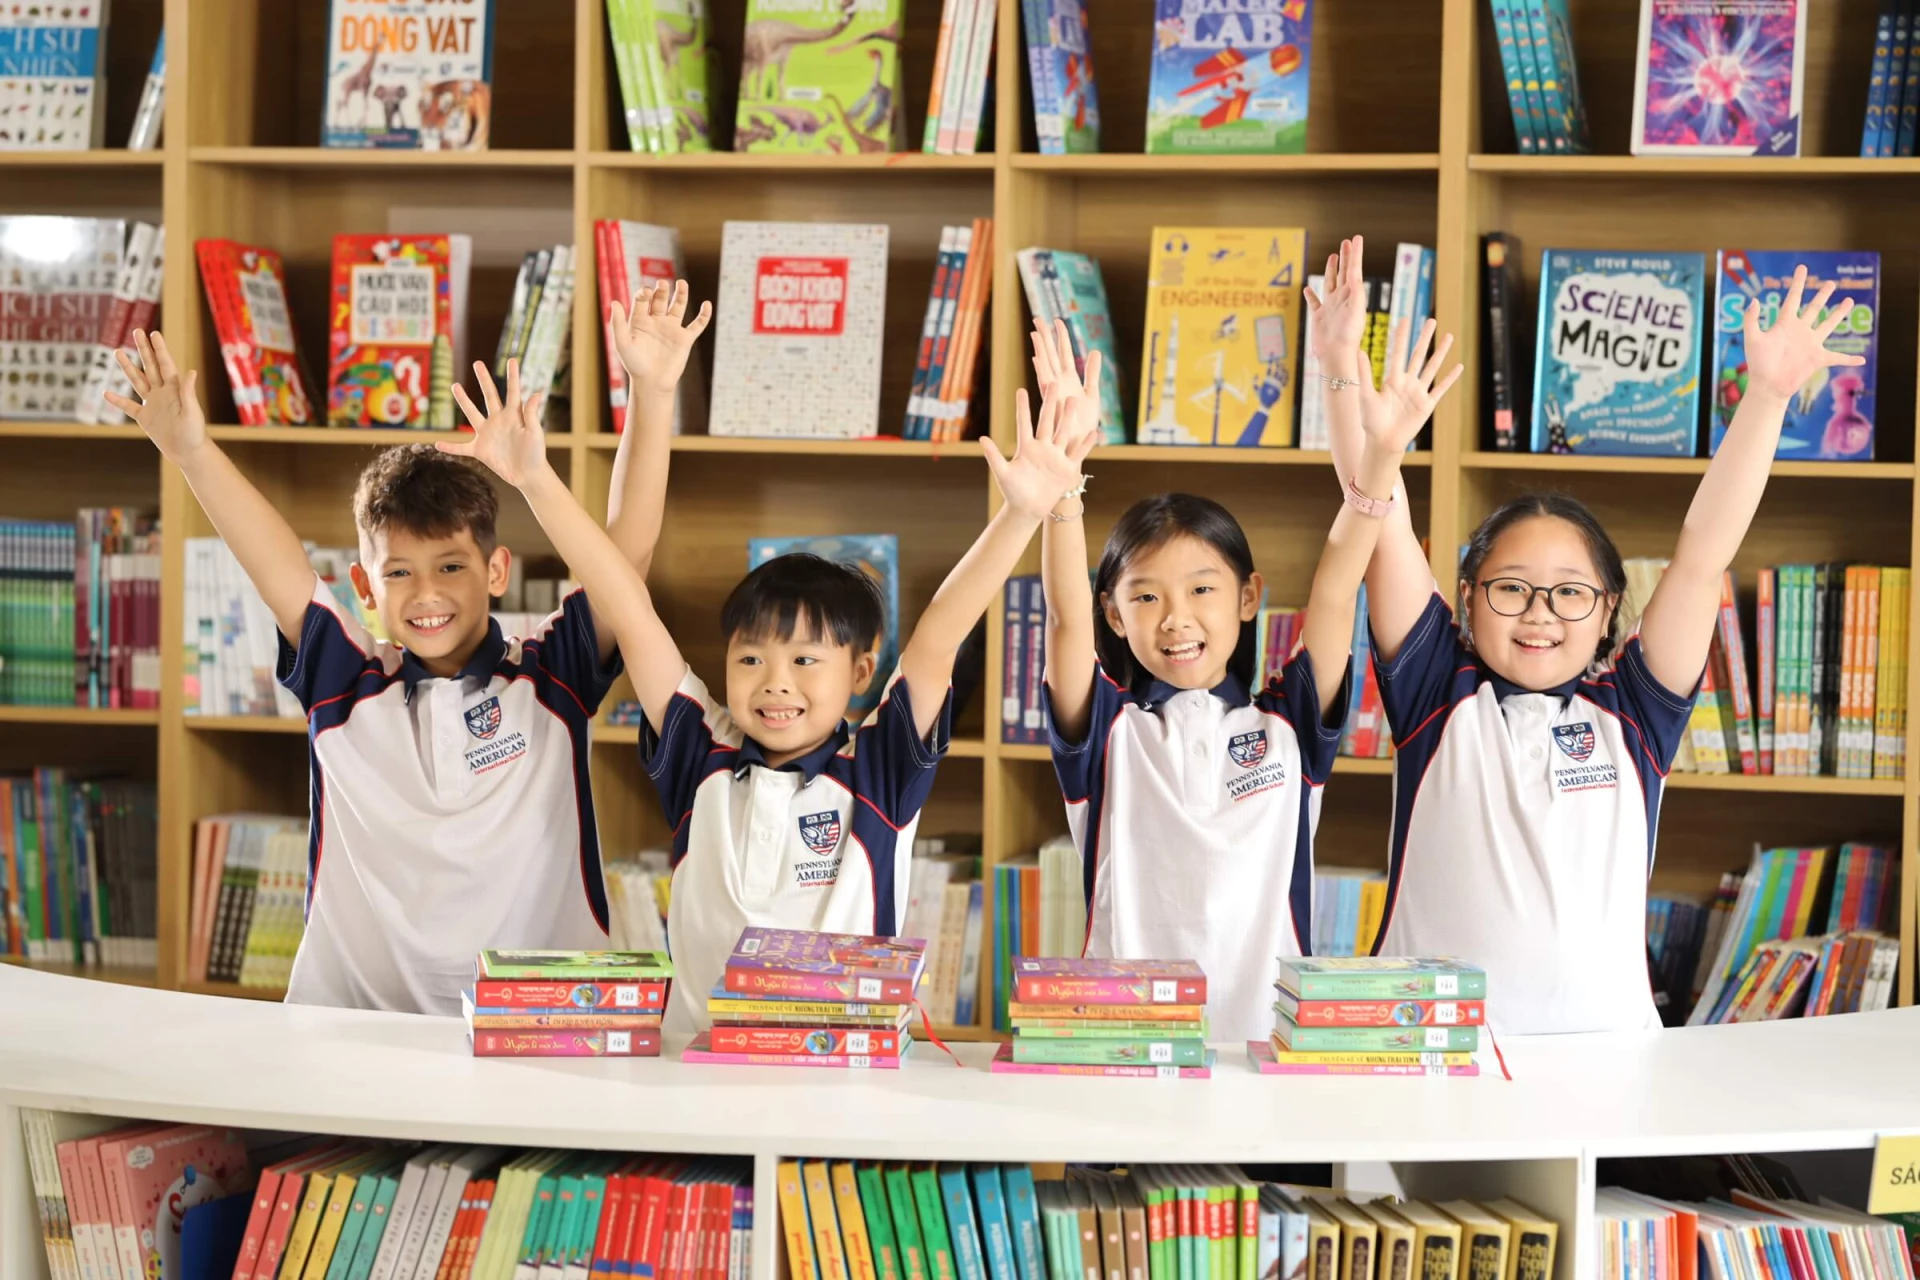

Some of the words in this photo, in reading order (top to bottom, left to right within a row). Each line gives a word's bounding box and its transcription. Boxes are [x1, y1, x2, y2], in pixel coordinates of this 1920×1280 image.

[1179, 13, 1285, 48] LAB
[1594, 257, 1628, 269] STEVE
[1160, 289, 1290, 308] ENGINEERING
[1560, 284, 1687, 330] SCIENCE
[1558, 319, 1680, 372] MAGIC
[464, 731, 523, 760] PENNSYLVANIA
[469, 738, 526, 771] AMERICAN
[1226, 762, 1283, 789] PENNSYLVANIA
[1230, 770, 1286, 798] AMERICAN
[1555, 764, 1616, 777] PENNSYLVANIA
[1557, 772, 1618, 787] AMERICAN
[796, 868, 838, 882] AMERIC
[1890, 1161, 1920, 1185] SÁ
